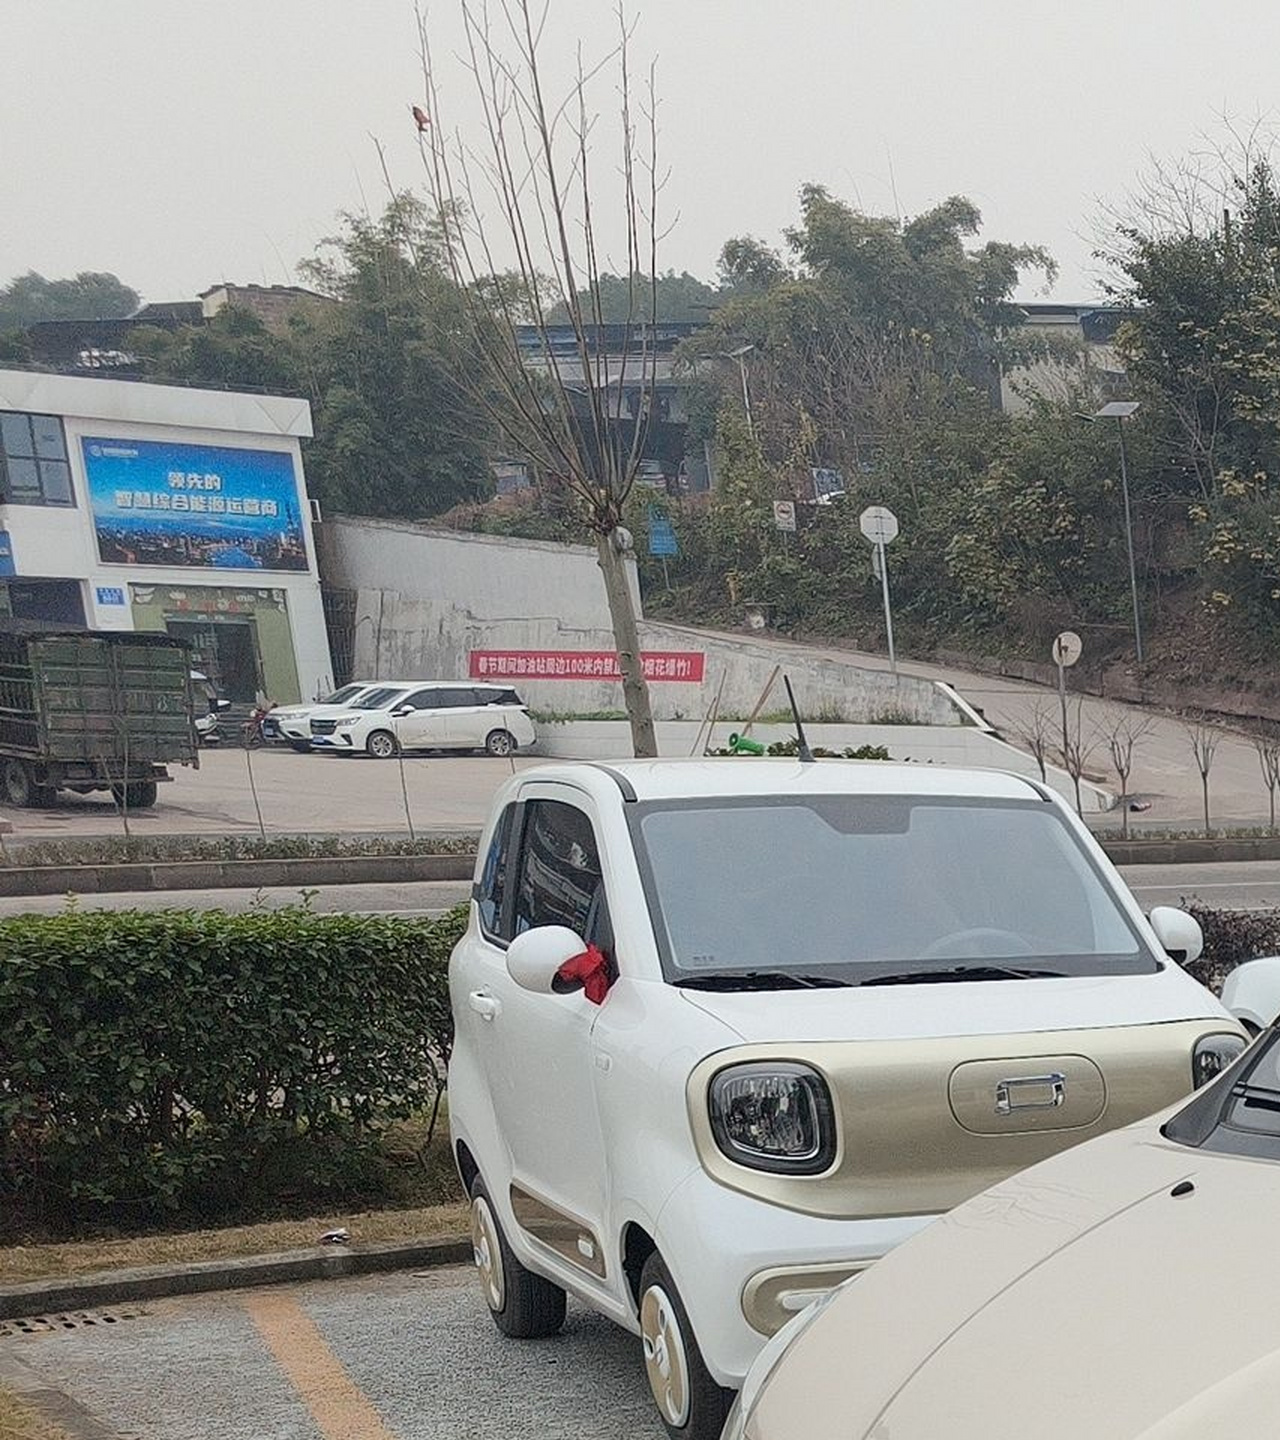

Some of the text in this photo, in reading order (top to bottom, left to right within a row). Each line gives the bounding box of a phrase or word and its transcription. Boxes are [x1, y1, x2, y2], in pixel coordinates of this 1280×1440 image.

[168, 471, 222, 490] 领先的
[115, 490, 278, 516] 智慧综合能源运营商
